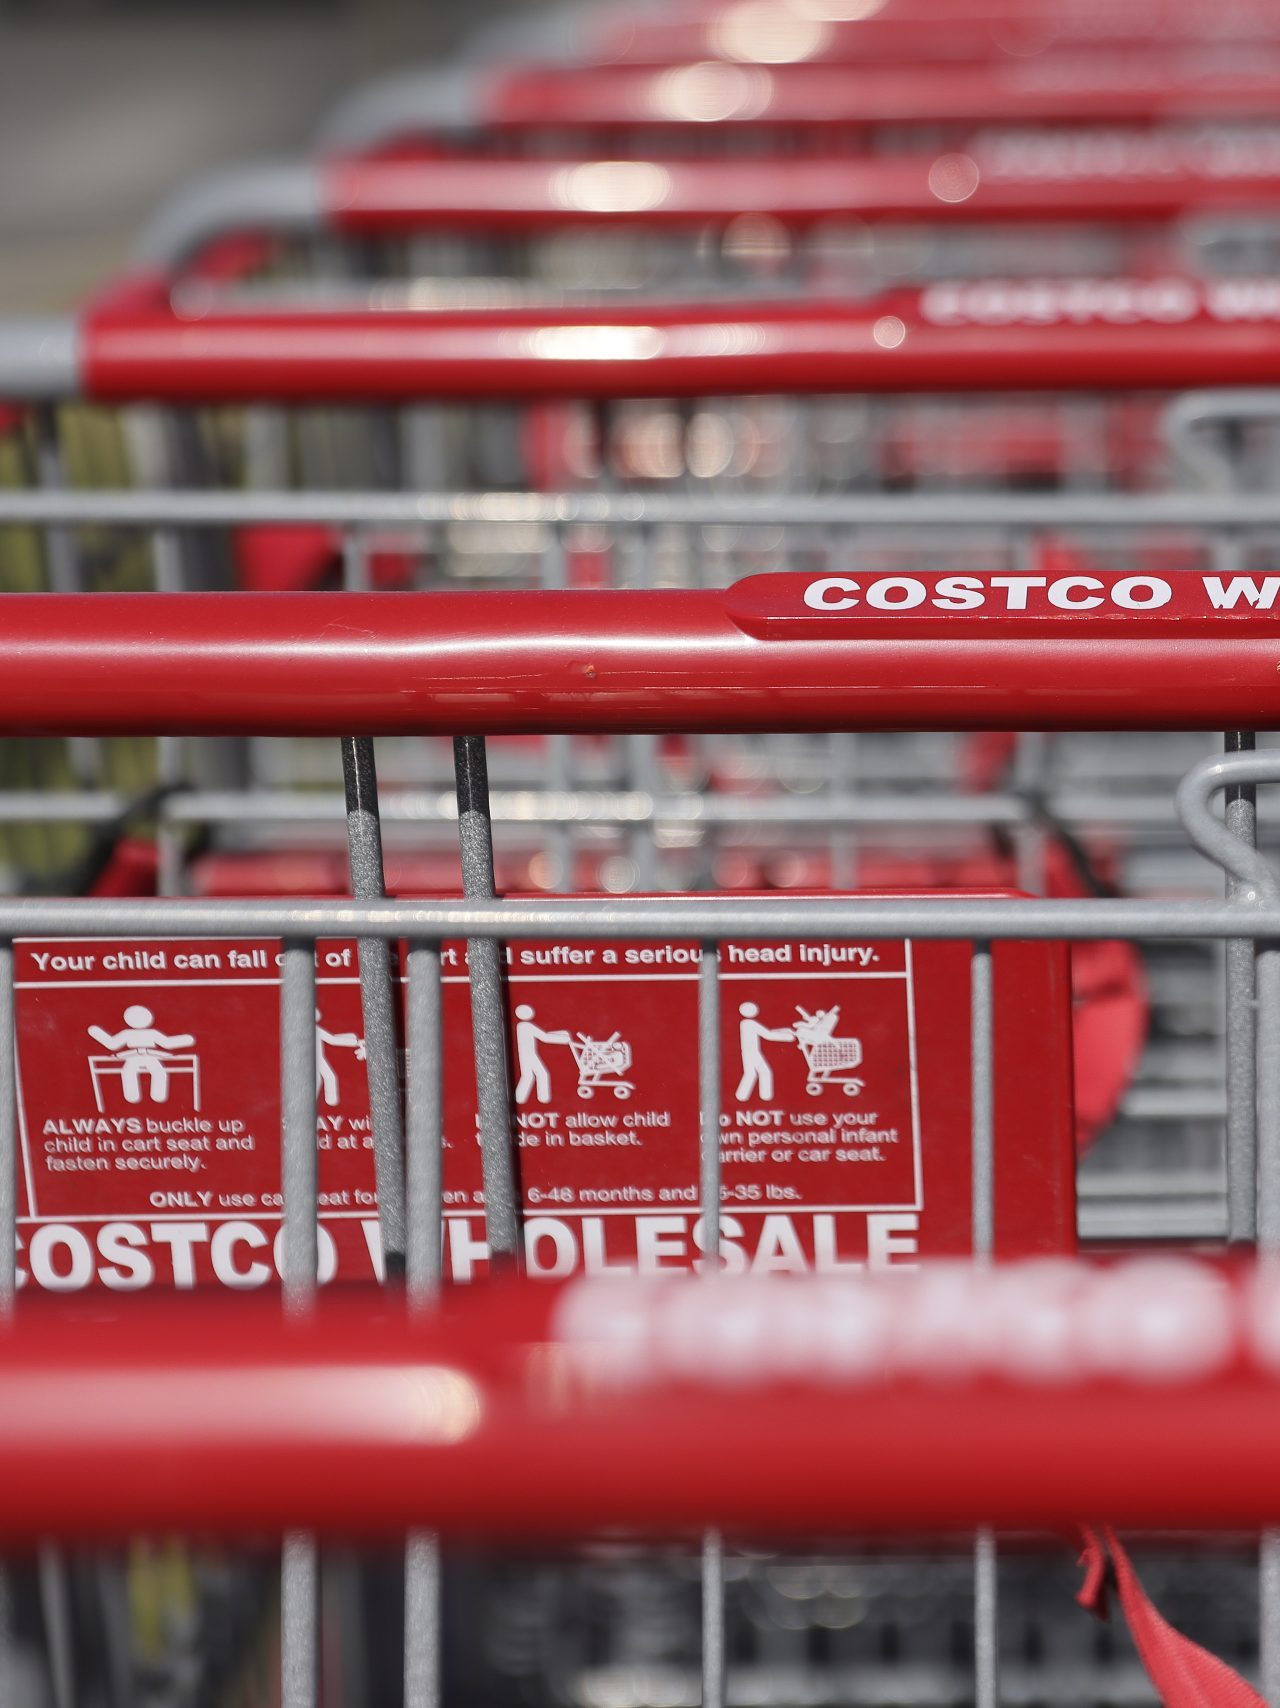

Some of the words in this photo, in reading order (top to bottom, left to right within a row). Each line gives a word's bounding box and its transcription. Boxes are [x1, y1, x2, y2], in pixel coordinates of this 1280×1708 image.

[803, 575, 1173, 612] COSTCO
[31, 952, 95, 971] Your
[102, 952, 167, 970] child
[173, 953, 221, 969] can
[227, 950, 268, 968] fall
[325, 949, 352, 967] of
[520, 946, 594, 965] suffer
[602, 951, 618, 964] a
[624, 946, 721, 964] seriou
[729, 945, 791, 963] head
[800, 944, 880, 966] injury.
[43, 1117, 142, 1135] ALWAYS
[146, 1116, 213, 1134] buckle
[218, 1119, 245, 1136] up
[565, 1110, 621, 1128] allow
[622, 1110, 671, 1128] child
[736, 1109, 785, 1127] NOT
[789, 1111, 828, 1126] use
[833, 1110, 879, 1129] your
[44, 1137, 91, 1153] child
[98, 1136, 116, 1152] in
[121, 1136, 161, 1152] cart
[166, 1136, 211, 1151] seat
[215, 1134, 255, 1151] and
[337, 1133, 358, 1150] at
[546, 1130, 563, 1147] in
[568, 1129, 643, 1147] basket.
[748, 1128, 837, 1148] personal
[841, 1127, 899, 1144] infant
[45, 1155, 109, 1172] fasten
[114, 1153, 208, 1174] securely.
[771, 1149, 793, 1163] or
[797, 1149, 832, 1163] car
[835, 1146, 887, 1162] seat.
[149, 1190, 213, 1208] ONLY
[218, 1192, 256, 1208] use
[318, 1189, 350, 1206] eat
[527, 1187, 574, 1203] 6-48
[578, 1185, 657, 1202] months
[658, 1185, 699, 1201] and
[765, 1183, 804, 1201] lbs.
